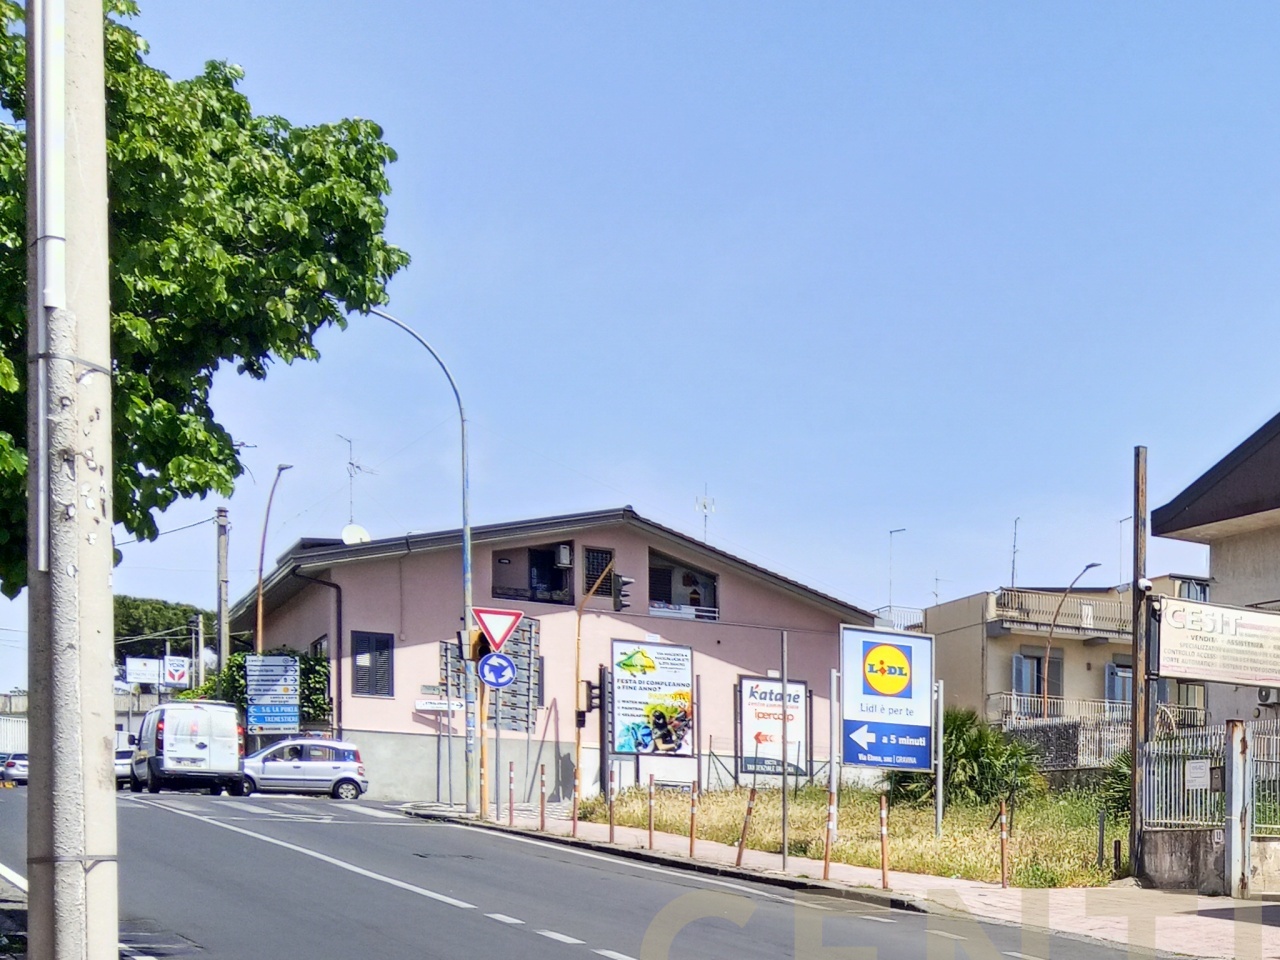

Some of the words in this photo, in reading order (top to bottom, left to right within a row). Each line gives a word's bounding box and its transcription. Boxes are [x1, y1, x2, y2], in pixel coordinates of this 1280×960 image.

[1165, 602, 1243, 637] CESIT
[646, 680, 690, 688] COMPLEANNO
[860, 703, 877, 713] Lidl
[888, 707, 902, 716] per
[906, 708, 914, 716] te
[882, 736, 888, 744] a
[890, 734, 896, 744] 5
[898, 735, 926, 746] minuti
[858, 753, 866, 761] Via
